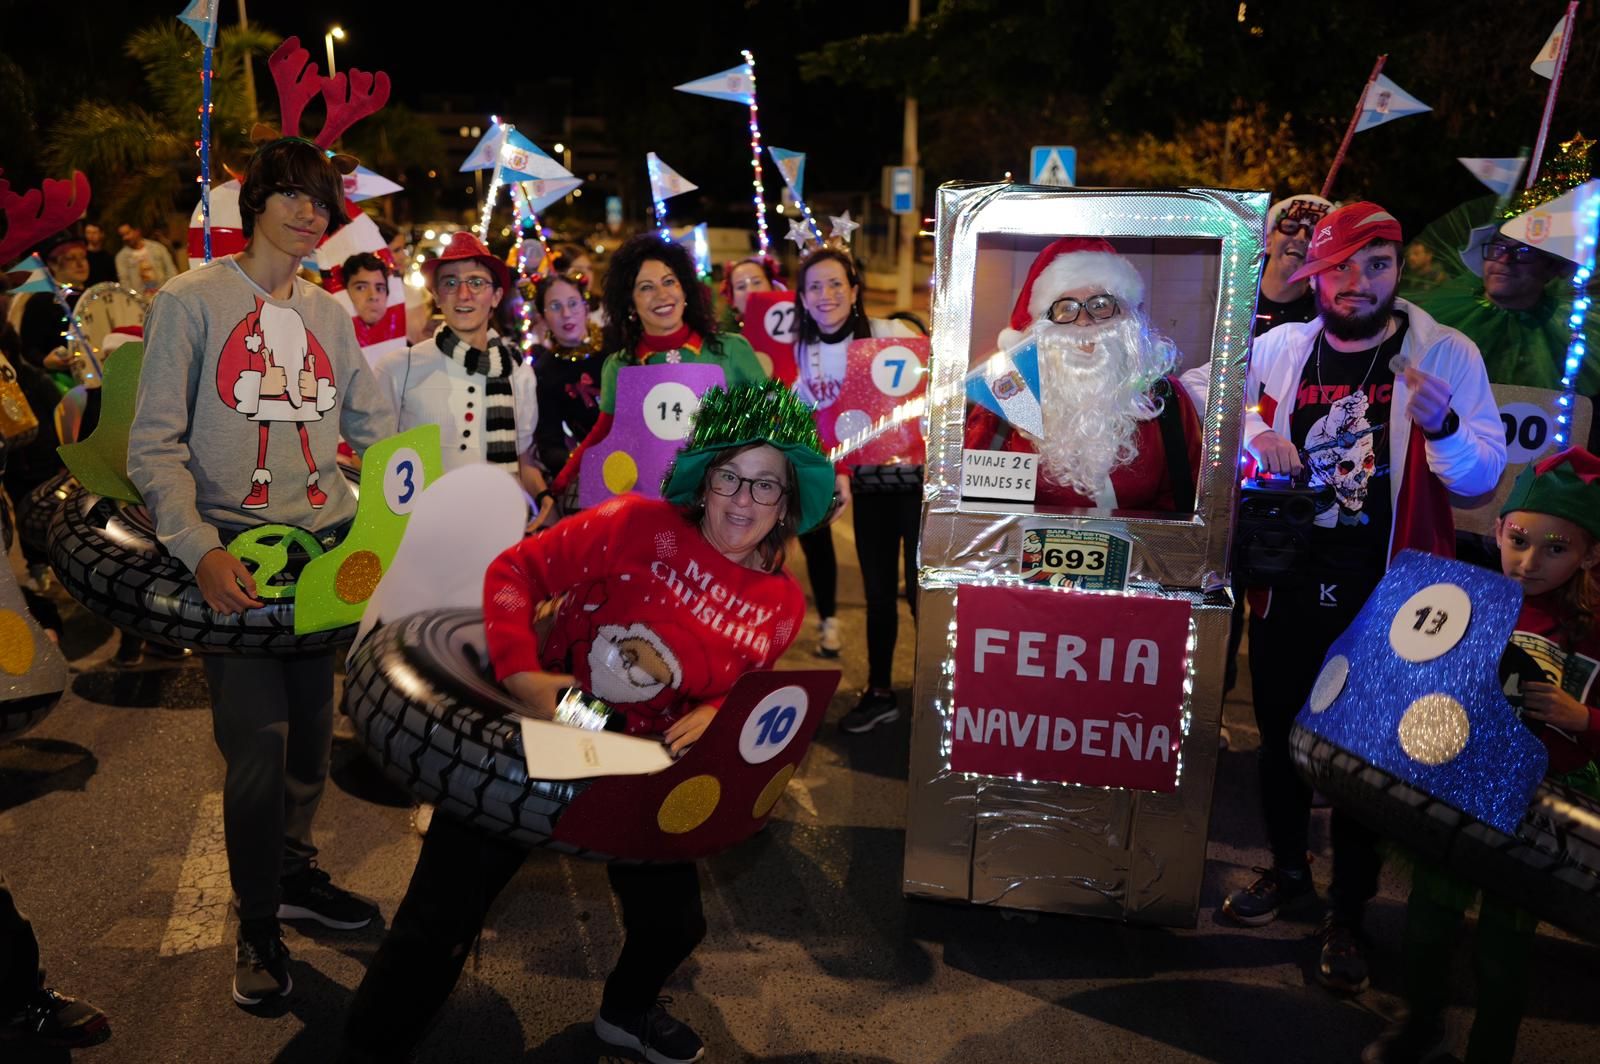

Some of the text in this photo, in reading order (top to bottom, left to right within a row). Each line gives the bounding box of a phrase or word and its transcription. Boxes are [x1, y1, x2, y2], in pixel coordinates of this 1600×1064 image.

[884, 360, 906, 388] 7
[657, 402, 682, 421] 14
[396, 460, 415, 504] 3
[1044, 548, 1105, 571] 693
[684, 559, 773, 627] Merry
[1412, 606, 1448, 635] 13
[973, 628, 1160, 686] FERIA
[755, 705, 797, 746] 10
[955, 706, 1170, 763] NAVIDEÑA
